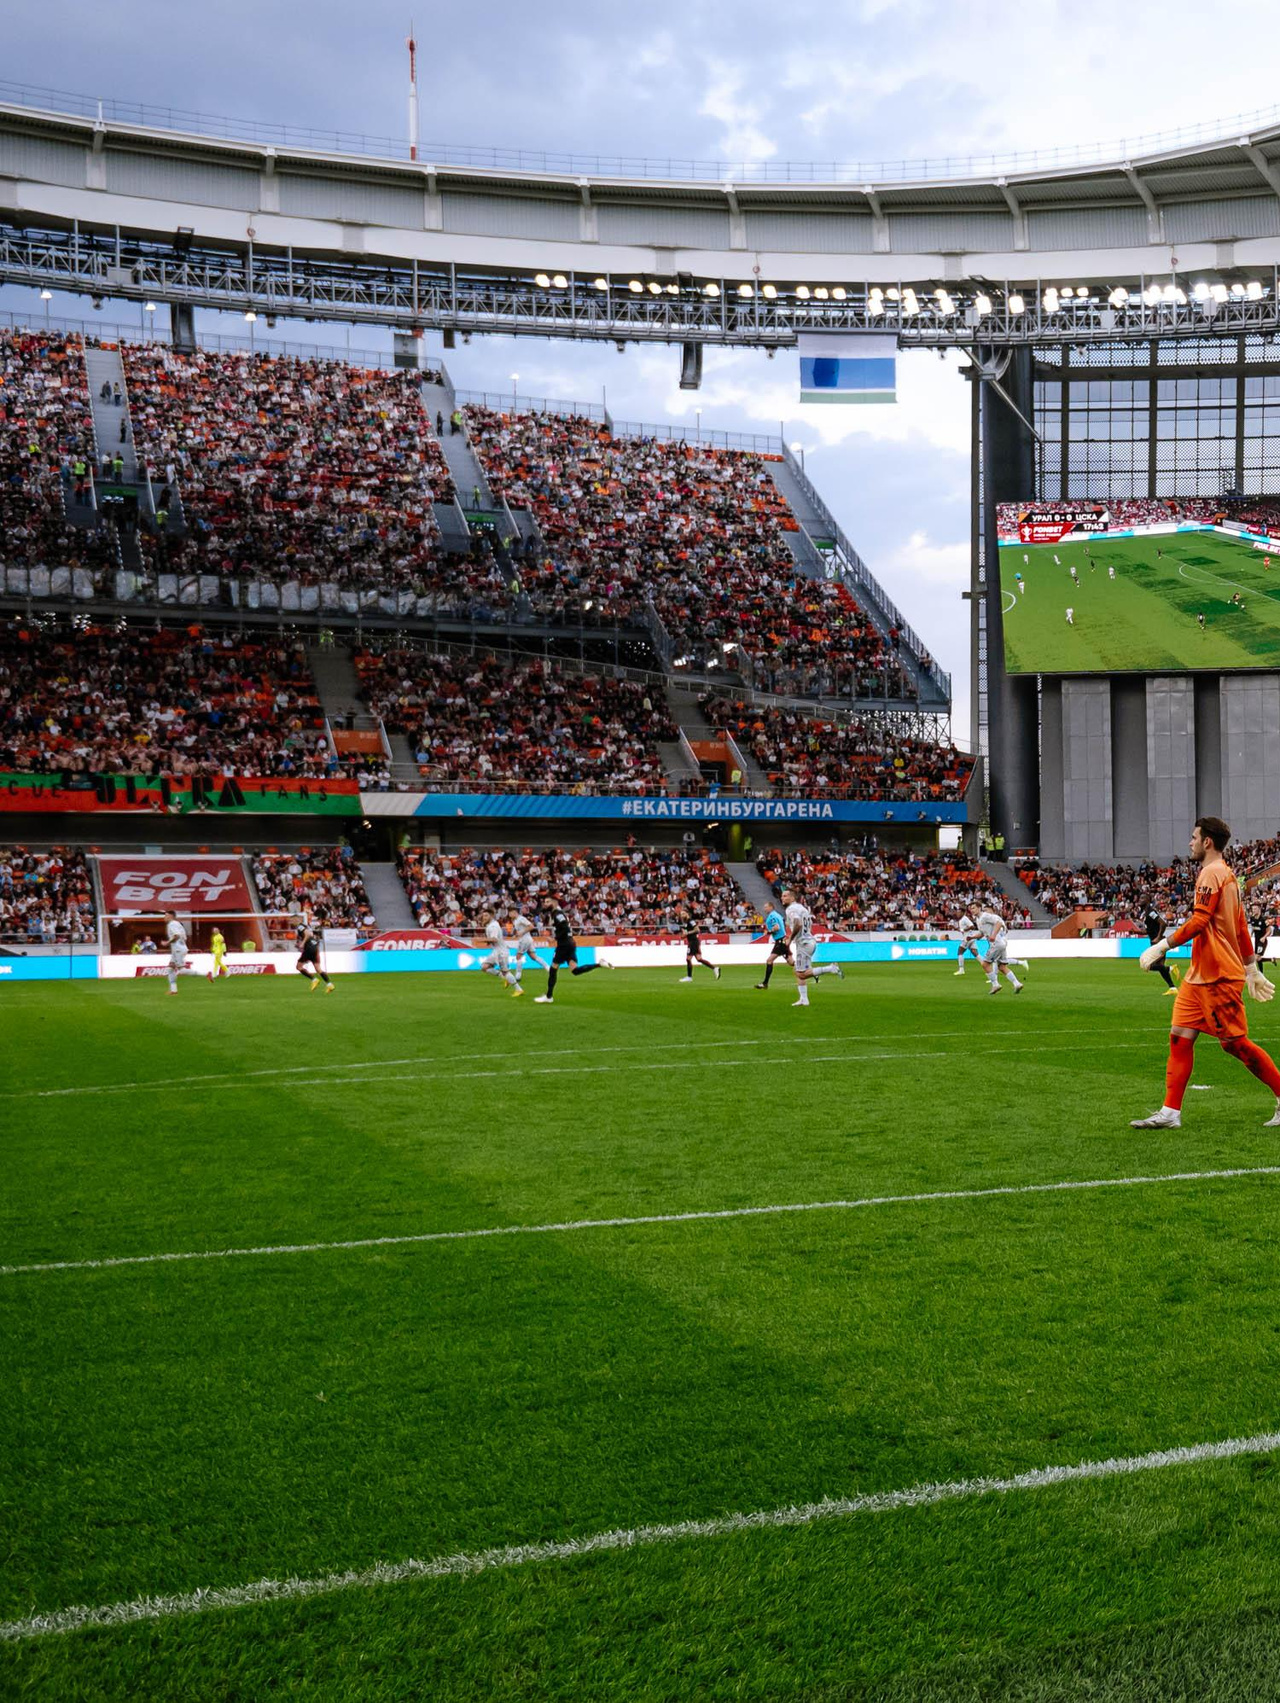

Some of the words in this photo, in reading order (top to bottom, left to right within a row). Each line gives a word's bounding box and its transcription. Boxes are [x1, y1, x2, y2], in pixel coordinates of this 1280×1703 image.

[1032, 514, 1053, 522] УРАЛ
[1075, 513, 1098, 521] ЦСКА
[260, 784, 327, 802] FANS
[622, 800, 833, 818] #ЕКАТЕРИНБУРГАРЕНА
[113, 869, 231, 887] FON
[115, 884, 235, 902] BET
